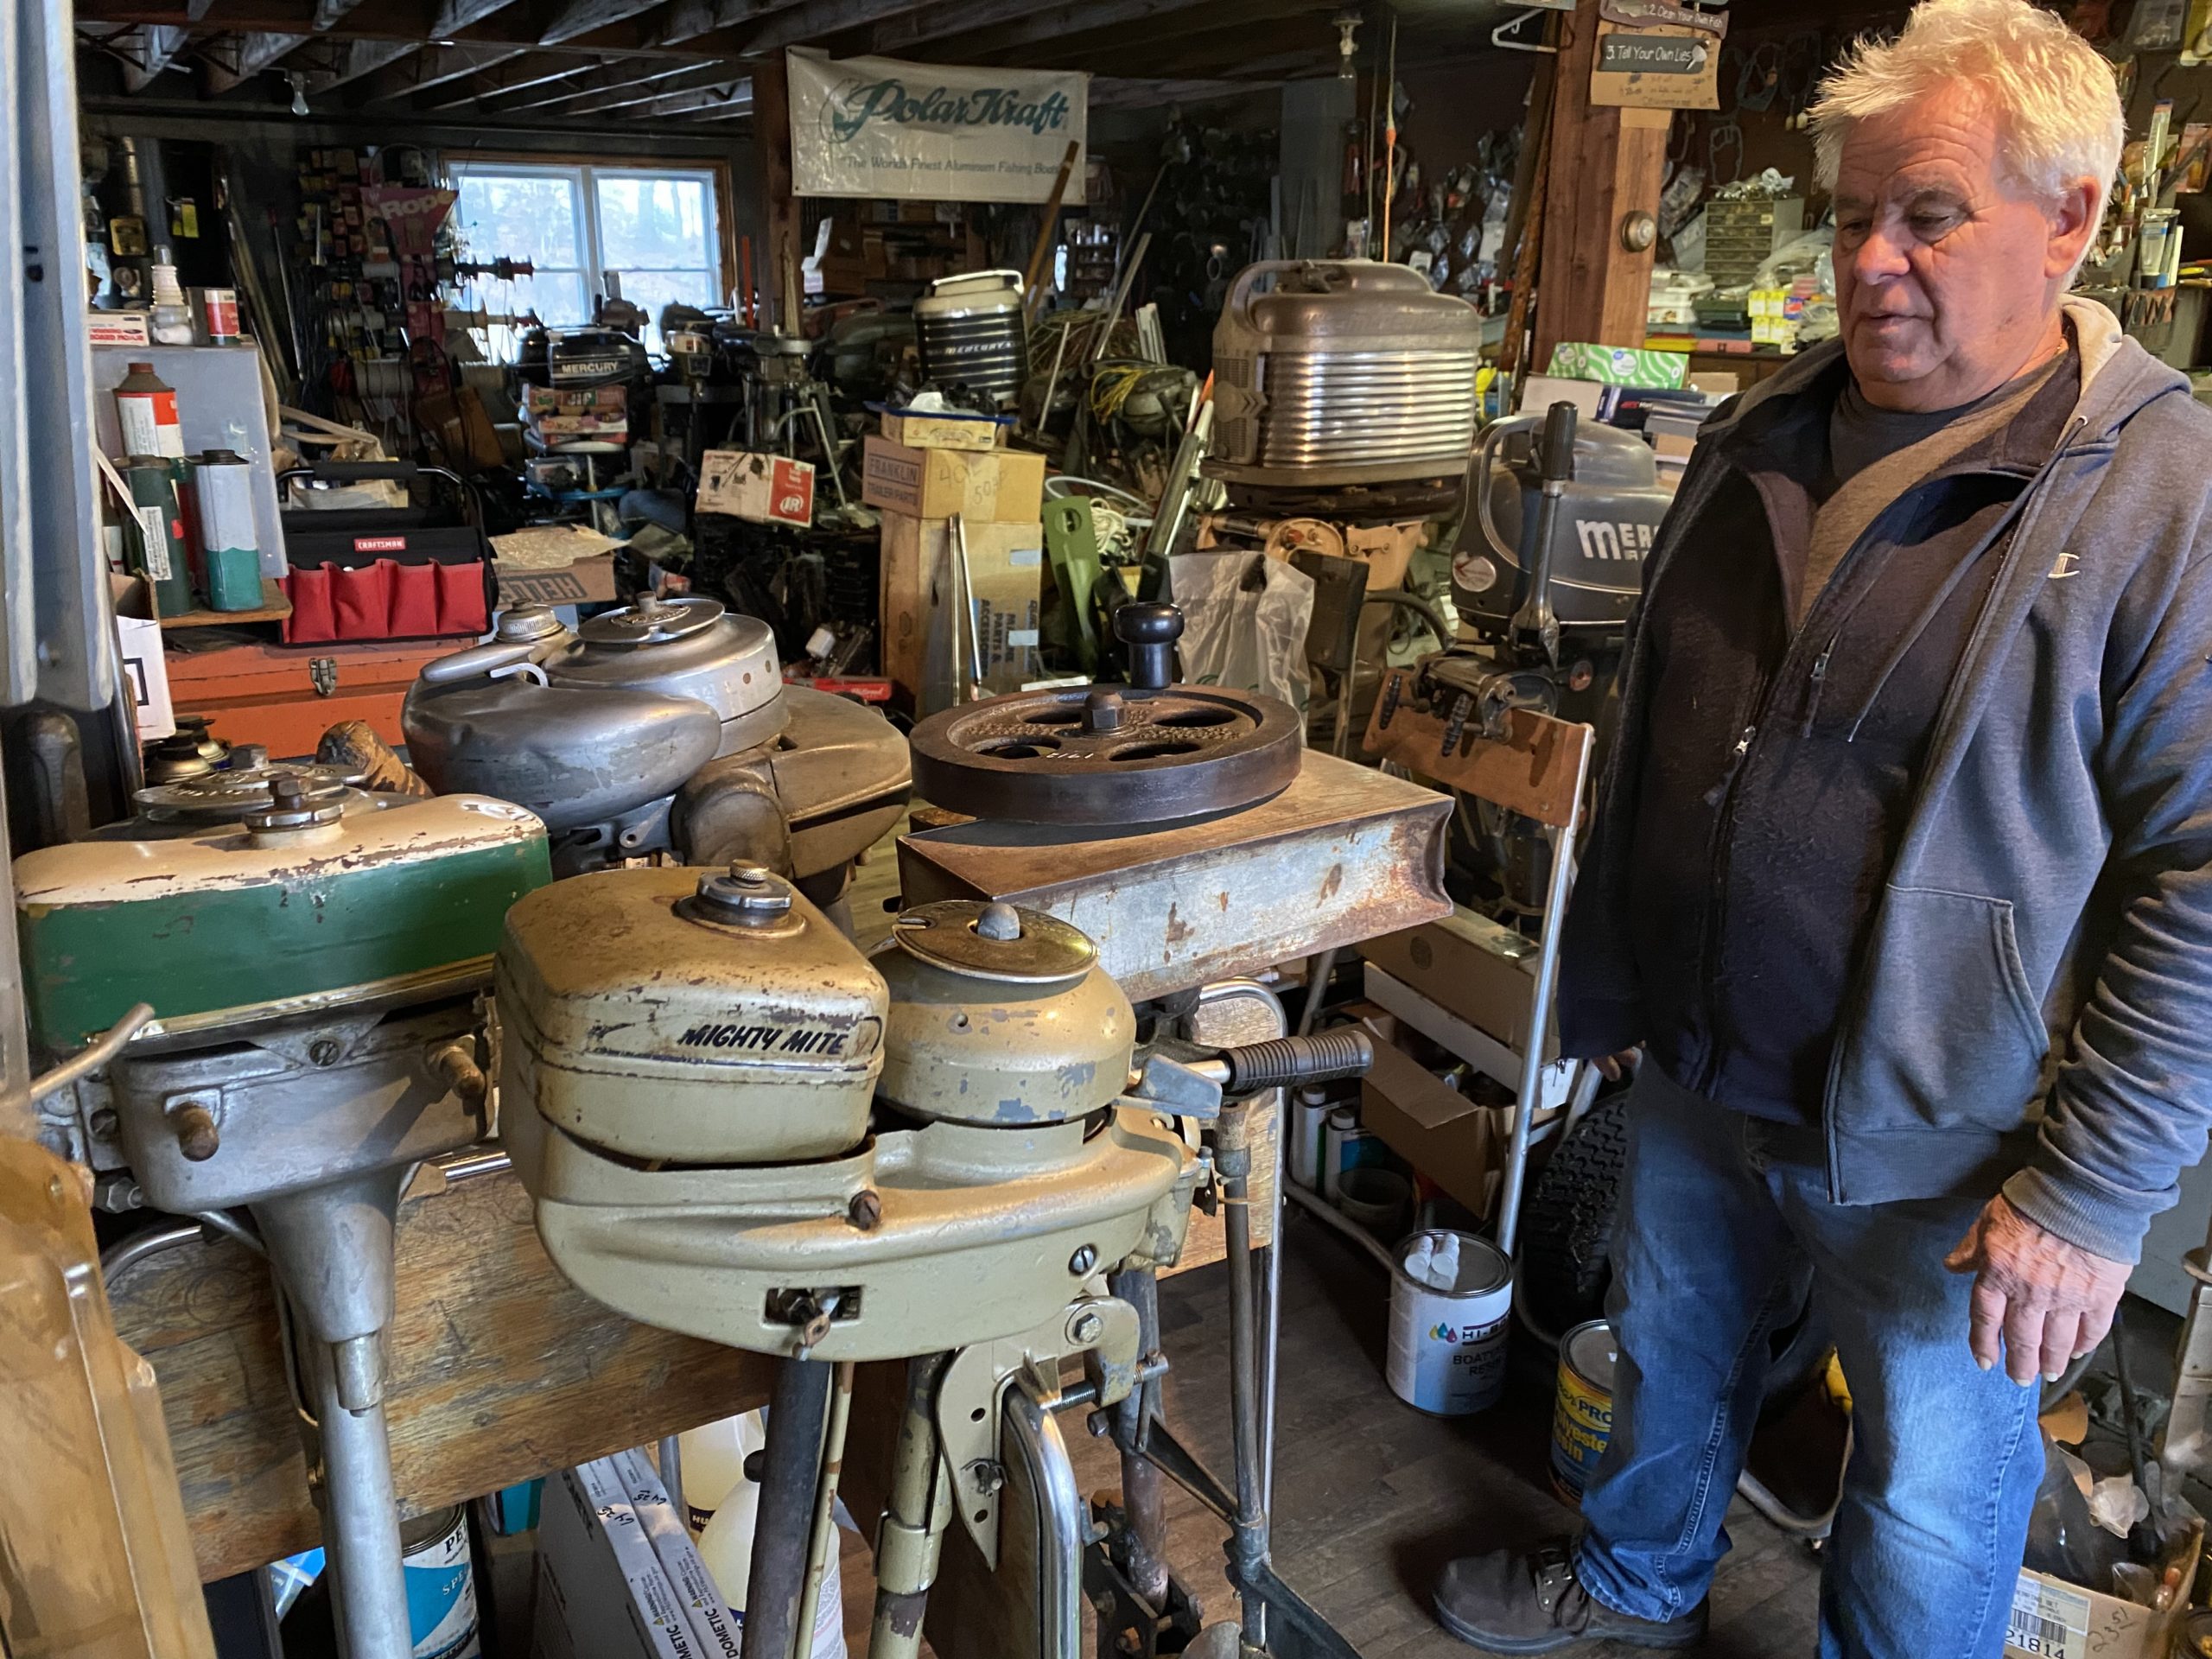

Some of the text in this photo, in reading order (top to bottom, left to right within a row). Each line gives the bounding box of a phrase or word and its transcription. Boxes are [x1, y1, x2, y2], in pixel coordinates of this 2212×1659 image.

[1677, 10, 1694, 22] Your
[1694, 12, 1708, 25] Own
[1709, 15, 1723, 28] Fish
[1618, 45, 1631, 60] Tell
[1633, 47, 1654, 60] Your
[1655, 47, 1674, 61] Own
[1675, 48, 1694, 62] Lies
[380, 191, 455, 220] Rope
[562, 361, 619, 373] MERCURY
[869, 457, 918, 486] FRANKLIN
[868, 481, 918, 507] TRAILER PARTS
[357, 539, 404, 550] CRAFTSMAN
[1575, 519, 1658, 560] MER
[995, 612, 1004, 647] PARTS
[677, 1024, 849, 1056] MIGHTY MITE
[1579, 1398, 1612, 1426] PRO
[704, 1607, 739, 1659] DOMETIC
